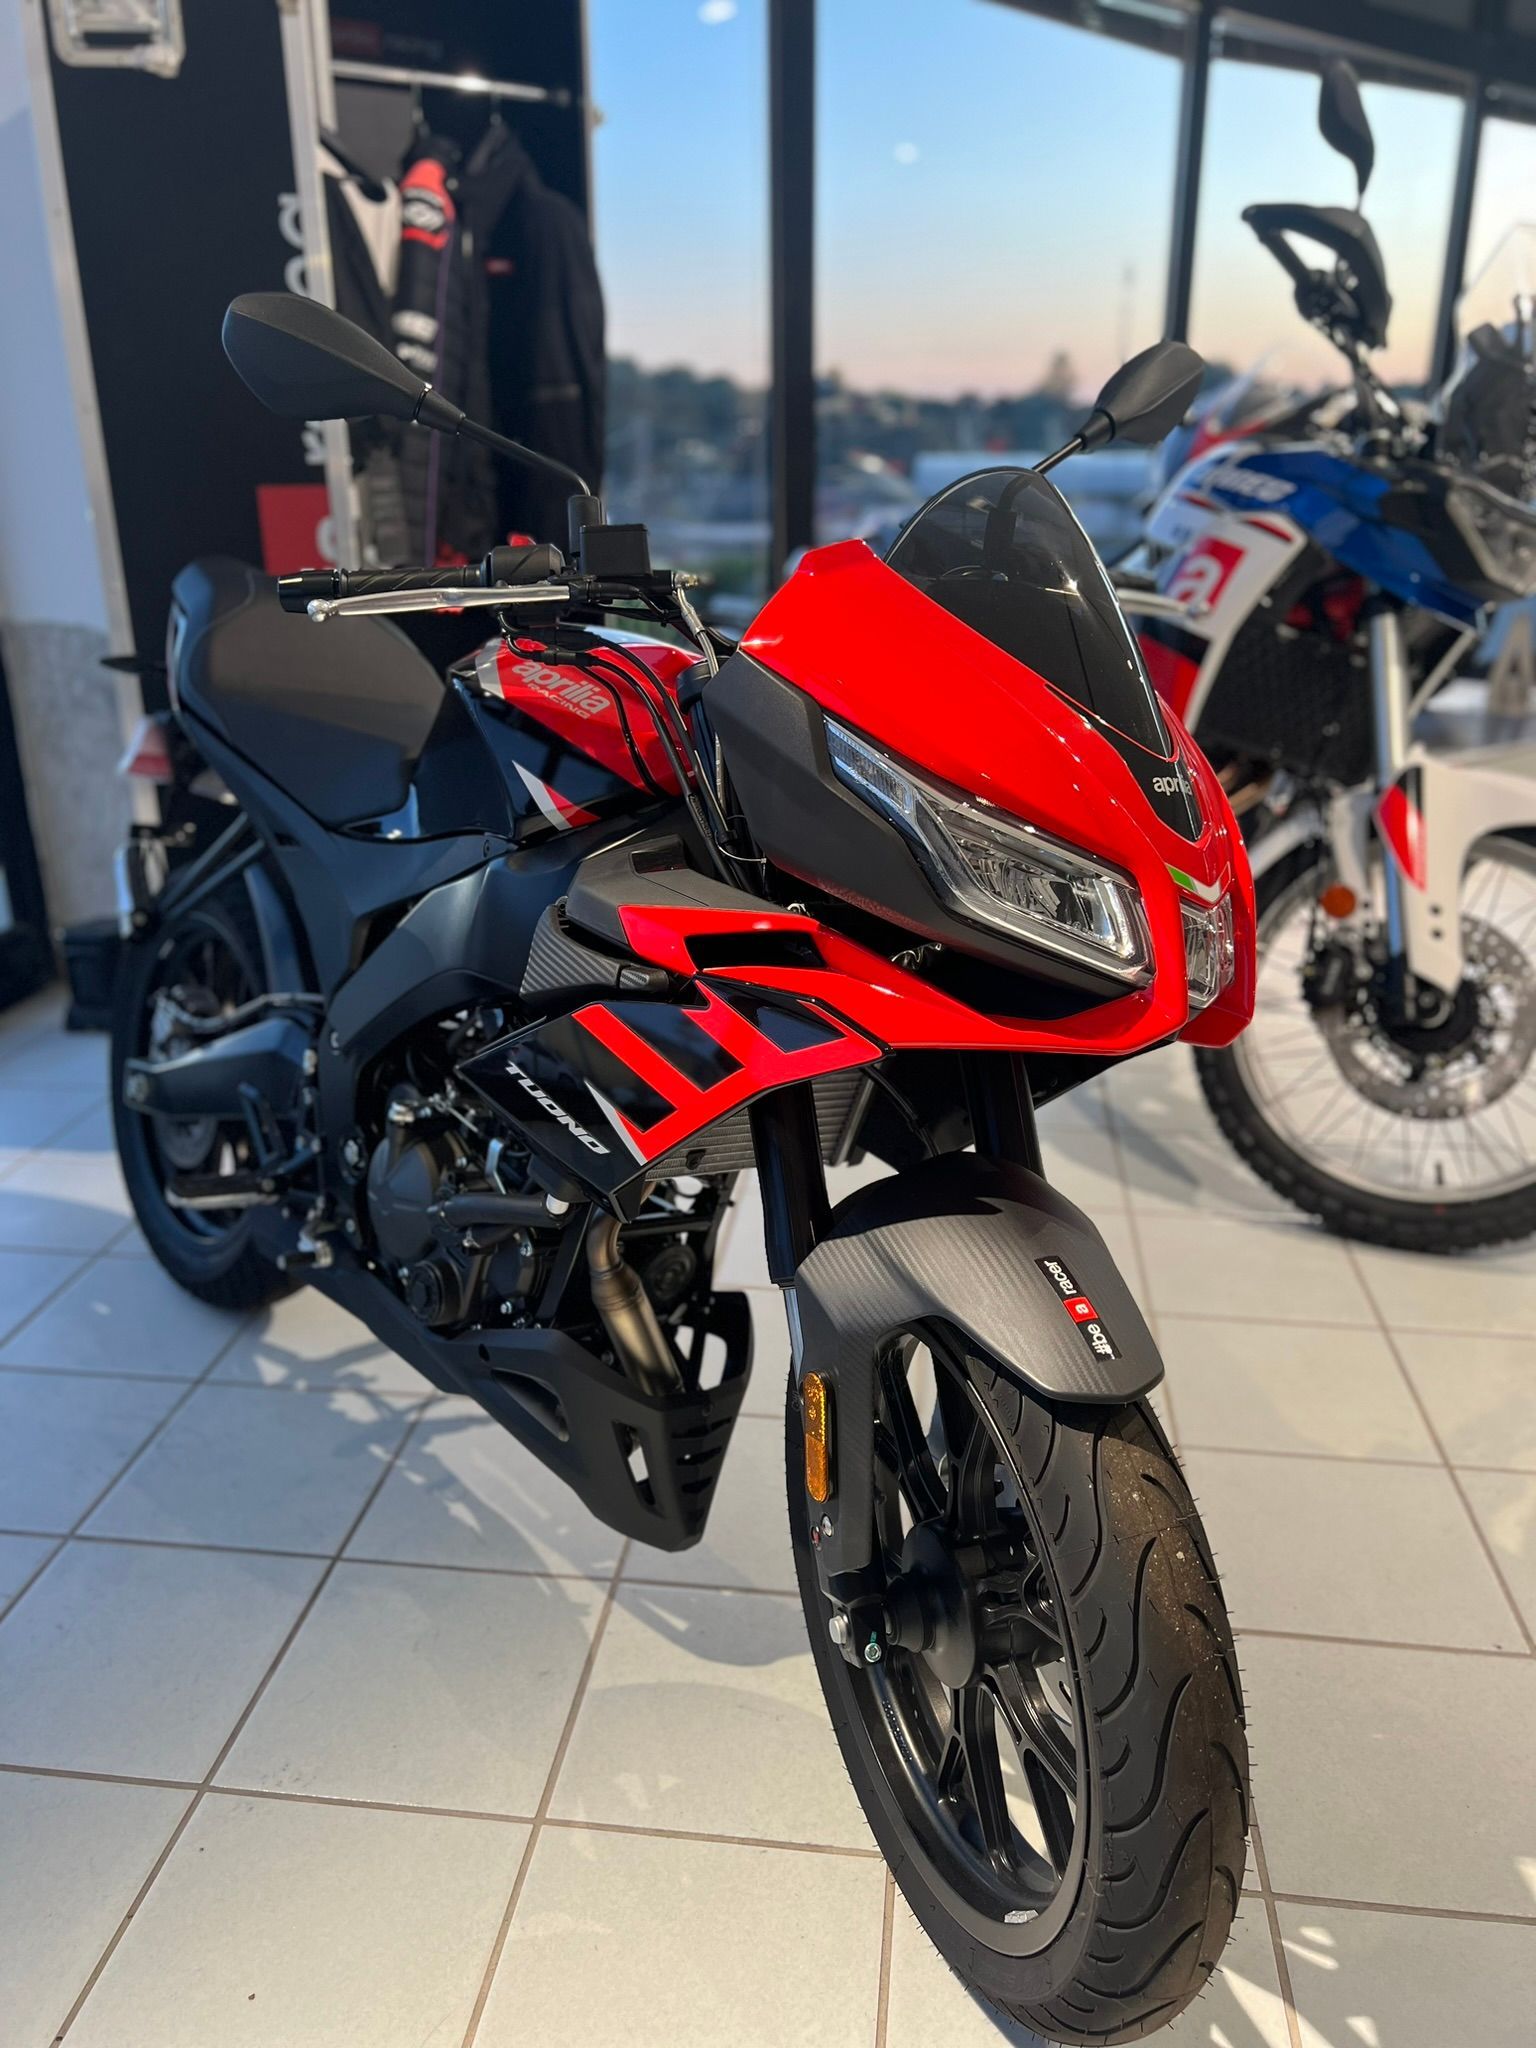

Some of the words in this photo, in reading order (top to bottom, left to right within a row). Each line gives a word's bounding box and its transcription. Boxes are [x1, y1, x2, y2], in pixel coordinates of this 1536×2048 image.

[512, 661, 611, 715] aprilia
[527, 684, 592, 720] RACING
[1152, 775, 1193, 796] apra
[505, 1060, 611, 1154] TUONO
[1043, 1260, 1077, 1295] racer
[1075, 1303, 1089, 1314] a
[1086, 1323, 1115, 1360] #be
